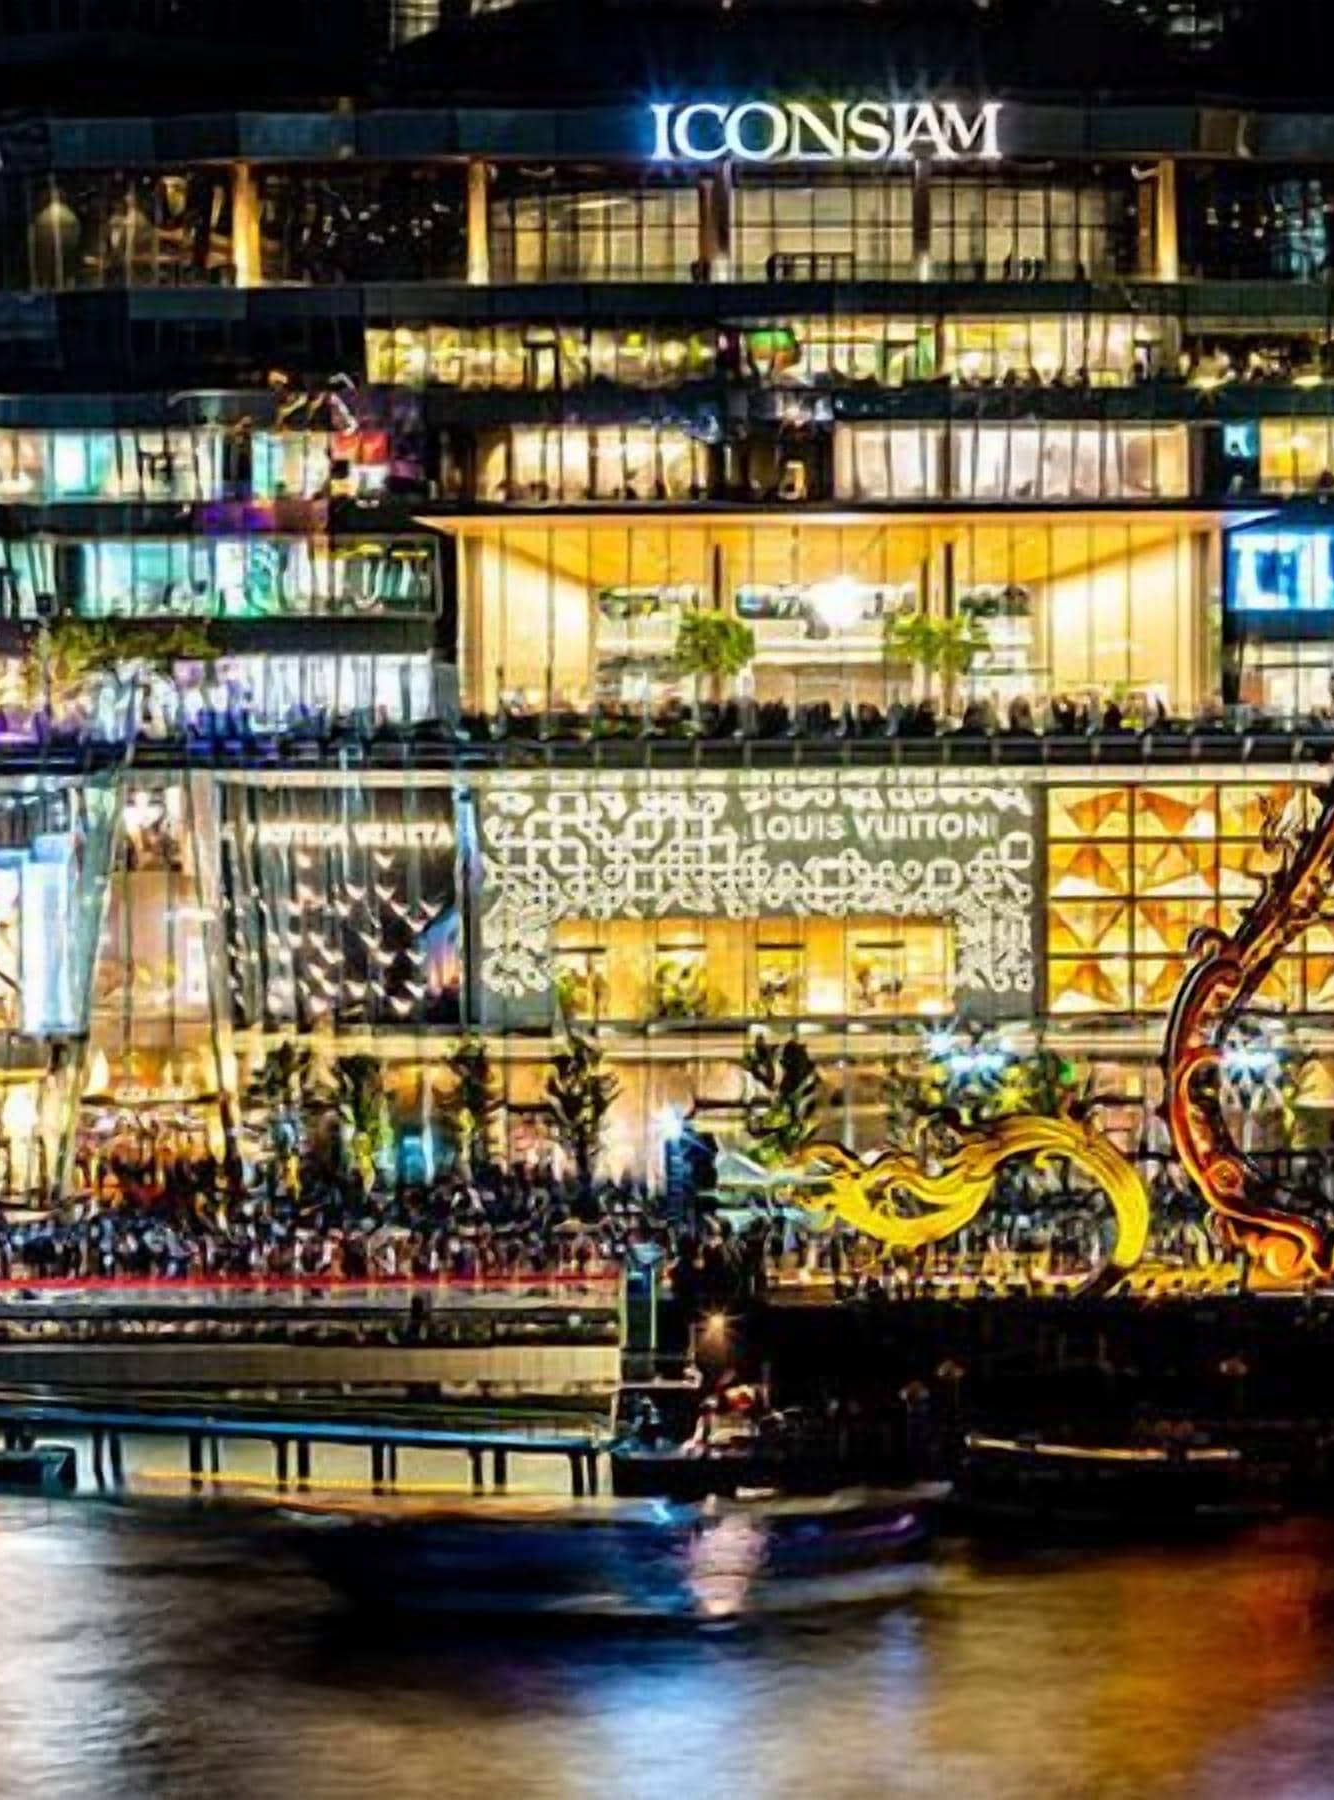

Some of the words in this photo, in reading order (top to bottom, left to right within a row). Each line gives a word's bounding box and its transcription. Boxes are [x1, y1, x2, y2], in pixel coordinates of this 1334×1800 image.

[650, 101, 1004, 161] ICONSIAM
[754, 812, 847, 841] LOUIS
[852, 812, 990, 841] VUITTON
